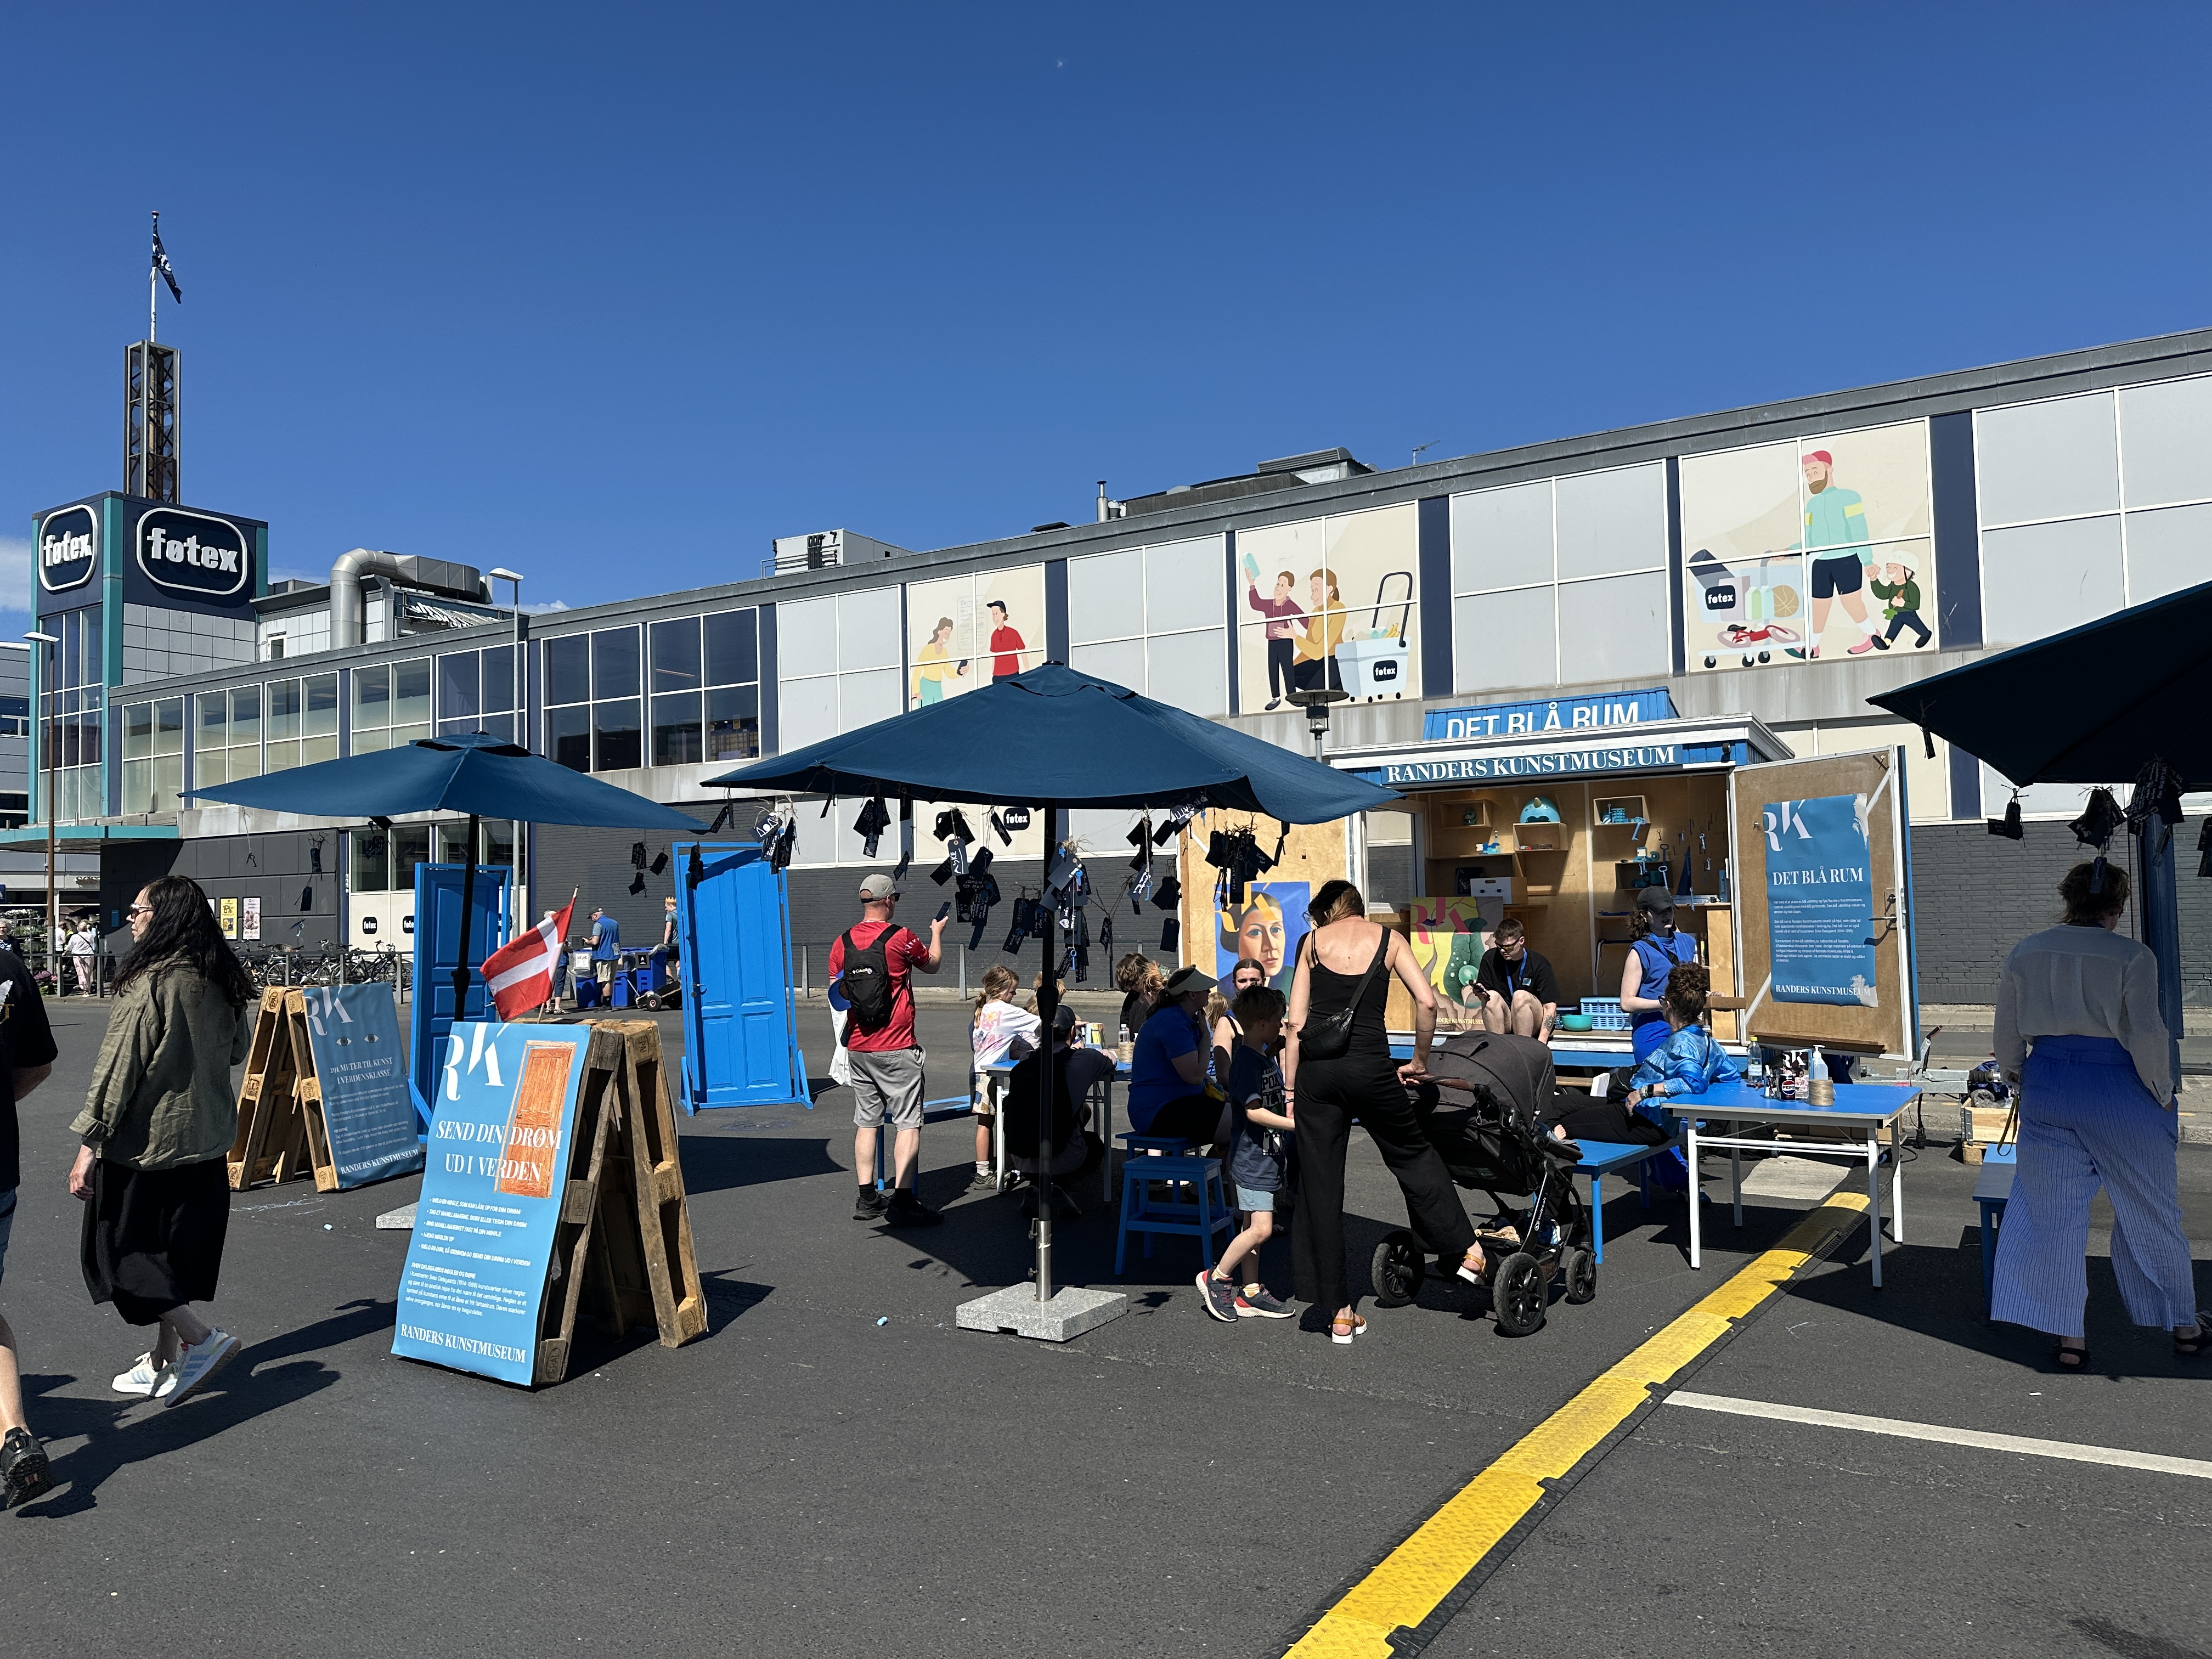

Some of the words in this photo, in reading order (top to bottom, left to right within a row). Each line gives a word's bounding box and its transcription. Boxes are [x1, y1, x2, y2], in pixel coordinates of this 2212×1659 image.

[44, 531, 92, 567] føtex
[146, 527, 238, 573] føtex
[1707, 591, 1734, 605] føtex
[1374, 666, 1396, 677] føtex
[1447, 715, 1500, 738] DET
[1508, 702, 1562, 733] BLÅ
[1572, 702, 1639, 727] RUM
[1387, 760, 1488, 783] RANDERS
[1493, 746, 1675, 776] KUNSTMUSEUM
[1006, 814, 1028, 824] føtex
[1773, 871, 1799, 885] DET
[1802, 866, 1827, 884] BLÅ
[1830, 867, 1864, 883] RUM
[364, 921, 376, 929] føtex
[403, 920, 415, 928] føte
[1775, 985, 1810, 994] RANDERS
[1811, 986, 1871, 996] KUNSTMUSEUM
[340, 1060, 362, 1073] METER
[362, 1059, 373, 1069] TIL
[373, 1057, 393, 1067] KUNST
[341, 1069, 391, 1084] VERDENSKLASSE
[436, 1120, 475, 1141] SEND
[475, 1124, 506, 1144] DIN
[509, 1126, 563, 1149] DRØM
[340, 1160, 371, 1175] RANDERS
[371, 1148, 419, 1167] KUNSTMUSEUM
[445, 1153, 465, 1173] UD
[467, 1156, 473, 1174] I
[478, 1156, 543, 1181] VERDEN
[486, 1229, 501, 1237] NØGLE
[513, 1258, 531, 1266] VERDEN
[400, 1323, 444, 1345] RANDERS
[445, 1334, 526, 1363] KUNSTMUSEUM
